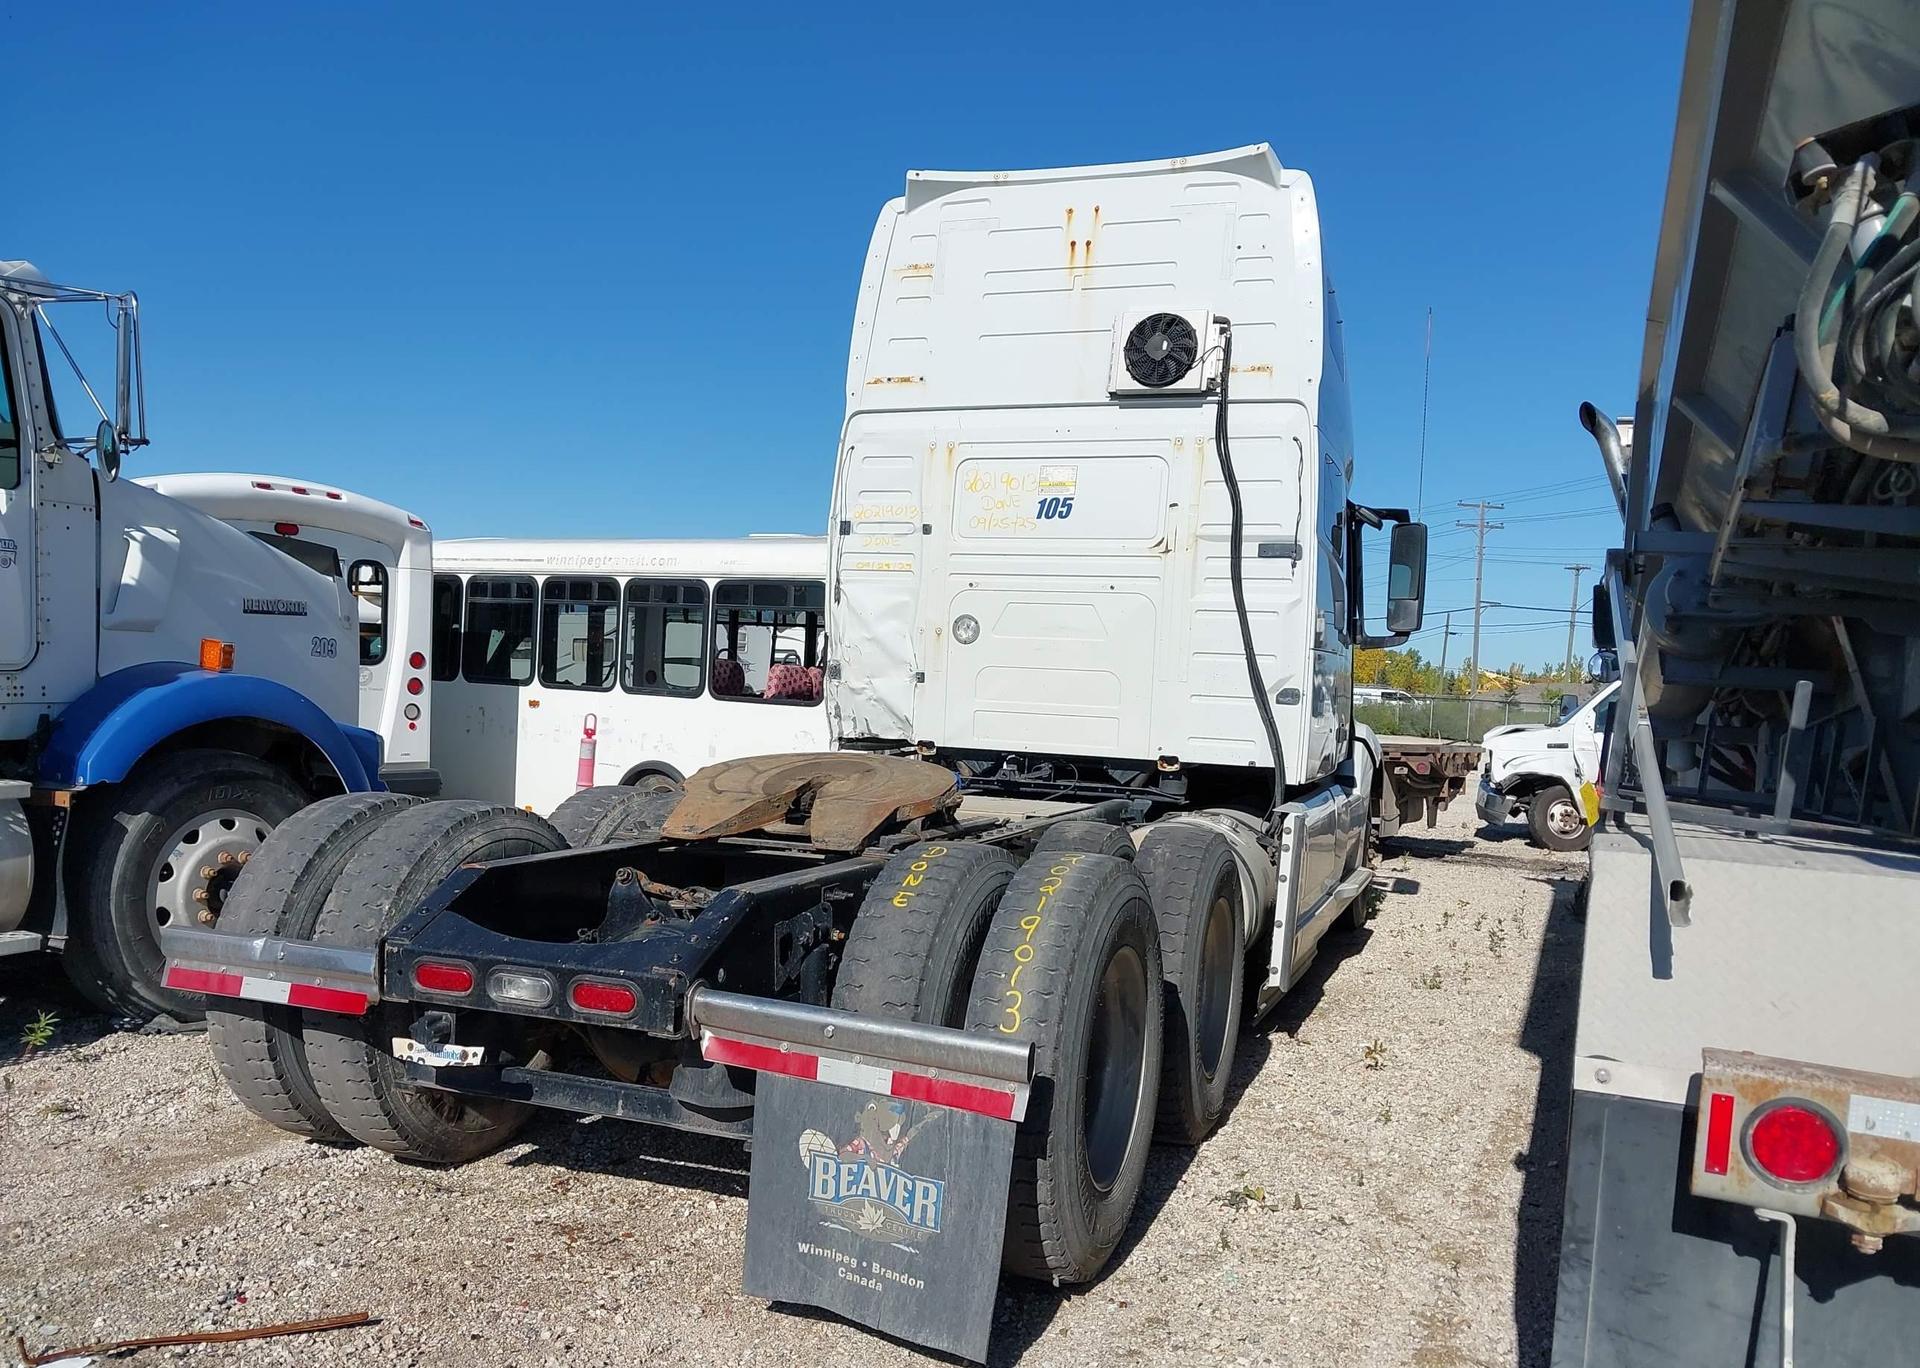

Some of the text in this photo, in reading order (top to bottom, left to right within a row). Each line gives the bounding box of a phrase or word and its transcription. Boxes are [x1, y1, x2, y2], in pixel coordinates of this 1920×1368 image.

[964, 468, 1038, 493] 20219013
[1036, 497, 1075, 520] 105
[863, 536, 902, 547] DONE
[243, 598, 308, 616] KENWORTH
[311, 636, 338, 659] 203
[893, 846, 948, 908] DONE
[999, 853, 1086, 1034] 20219013
[813, 1157, 938, 1229] BEAVER
[886, 1222, 924, 1240] CENTRE
[798, 1241, 925, 1290] Winnipeg Brandon
[838, 1266, 883, 1291] Canada
